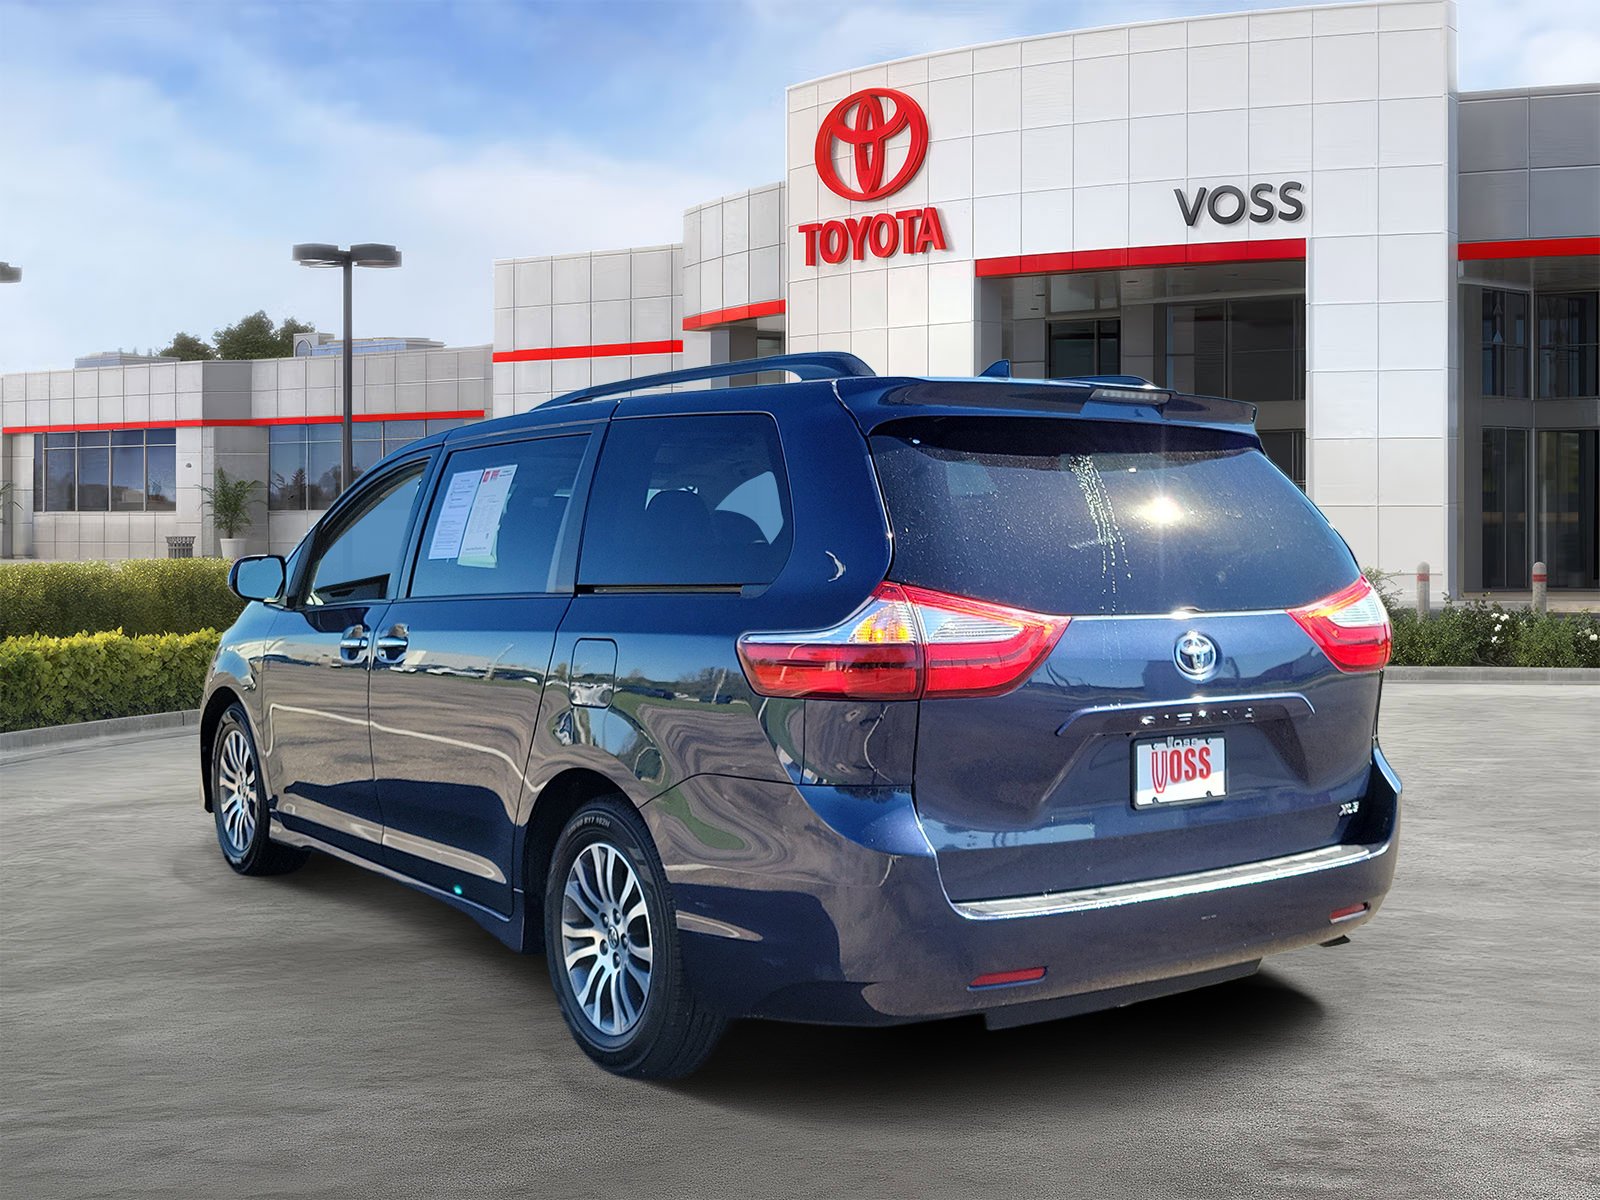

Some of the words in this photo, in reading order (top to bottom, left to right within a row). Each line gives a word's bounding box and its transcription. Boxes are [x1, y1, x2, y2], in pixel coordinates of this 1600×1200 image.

[1173, 181, 1306, 227] VOSS
[798, 206, 948, 266] TOYOTA
[1151, 746, 1212, 794] VOSS
